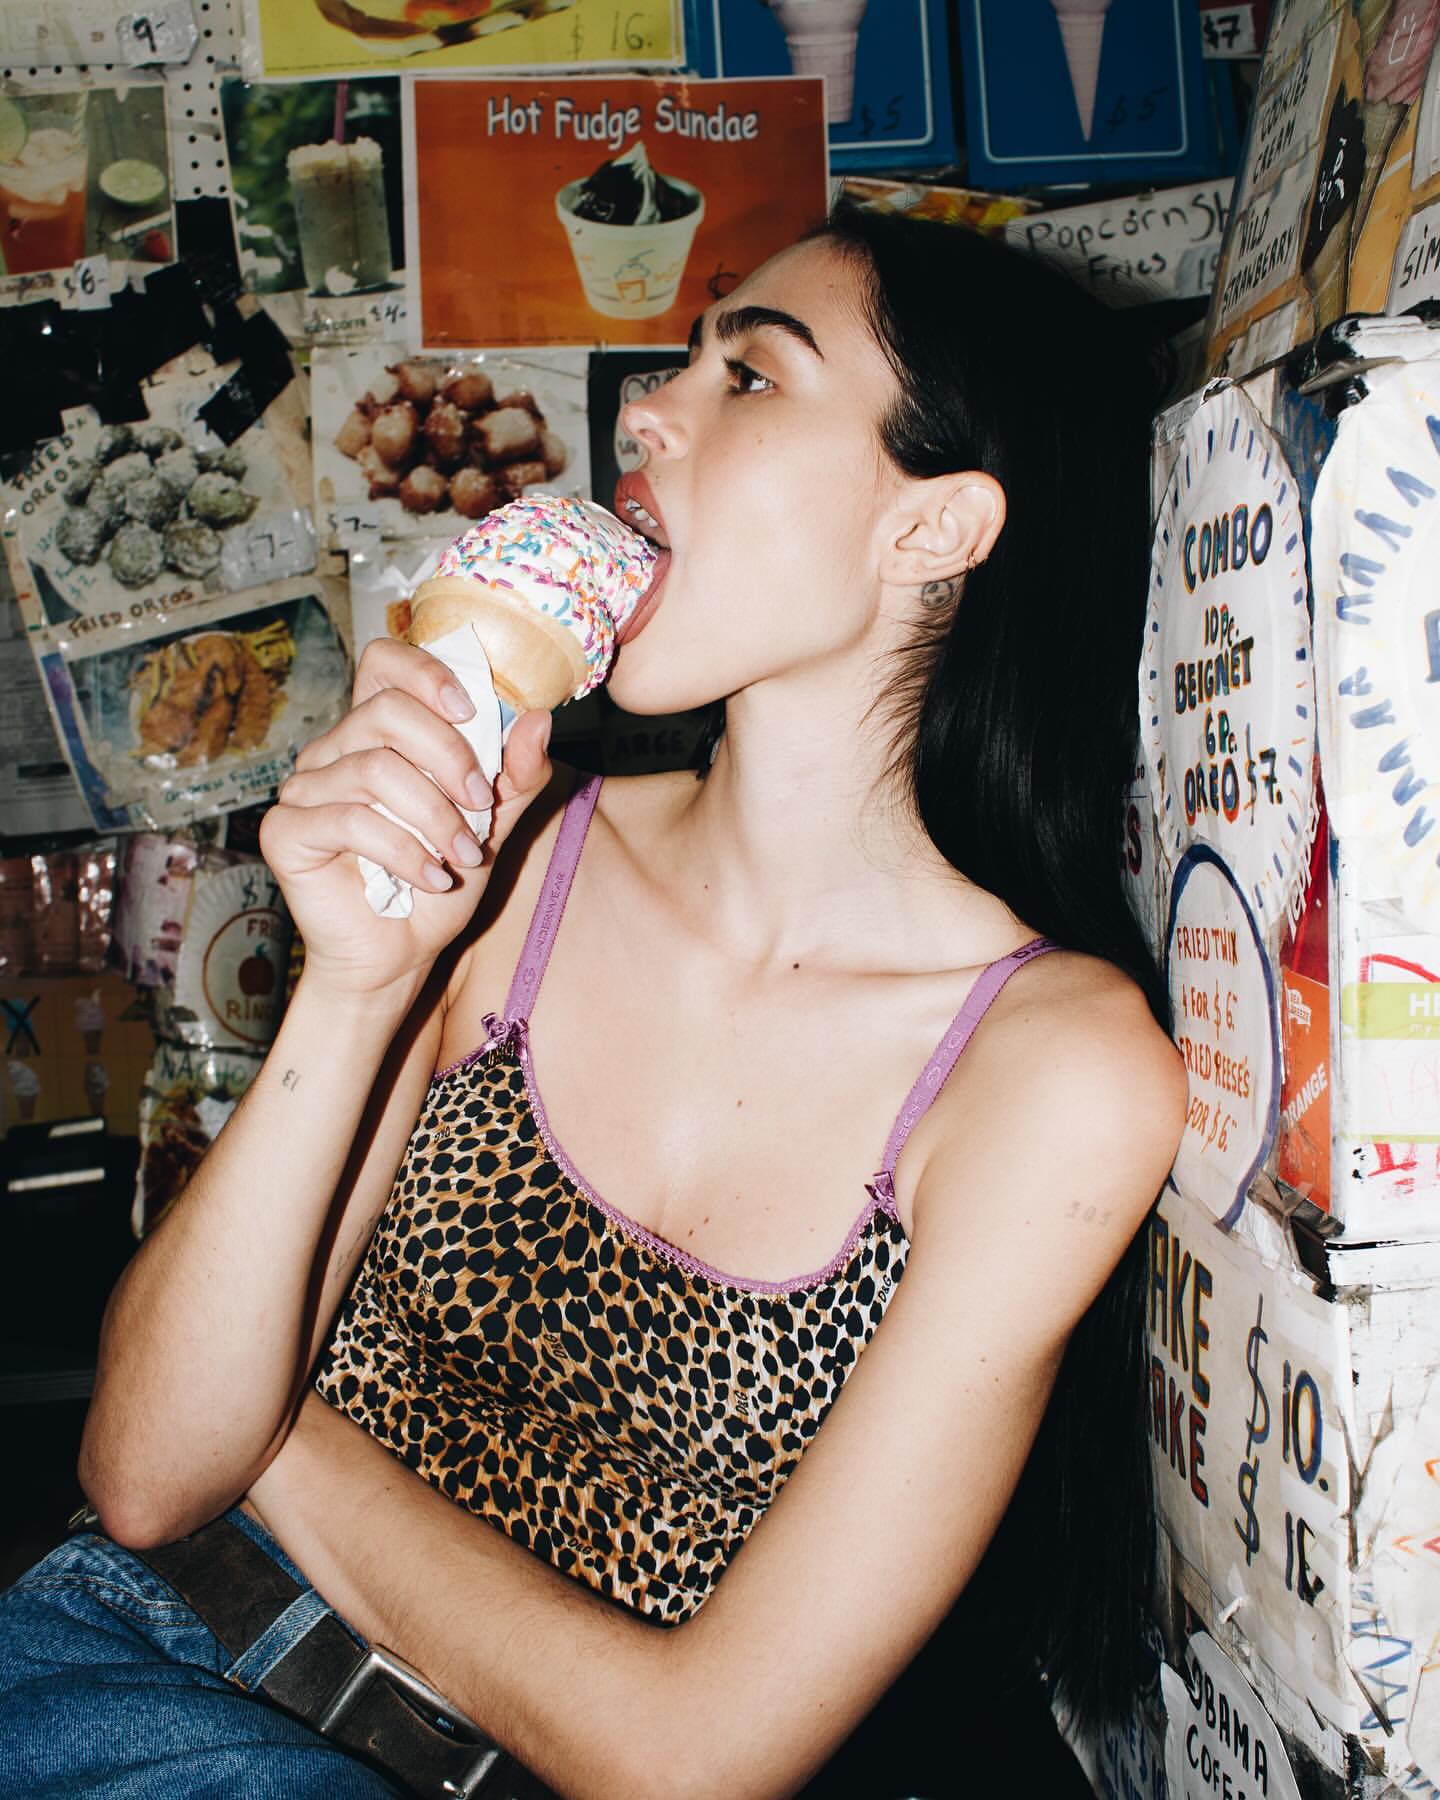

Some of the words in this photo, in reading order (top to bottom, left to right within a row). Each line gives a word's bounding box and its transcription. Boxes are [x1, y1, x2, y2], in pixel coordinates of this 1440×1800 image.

[1203, 14, 1241, 48] $7
[487, 95, 542, 136] Hot
[555, 98, 641, 150] Fudge
[655, 96, 759, 142] Sundae
[1253, 112, 1297, 184] CREAM
[1222, 224, 1295, 314] STRAWBERRY
[22, 456, 80, 515] OREOS
[1180, 502, 1273, 594] COMBO
[68, 610, 122, 638] FRIED
[1174, 634, 1255, 716] BEIGNET
[1184, 757, 1241, 827] OREO
[534, 870, 566, 956] UNDERWEAR
[1176, 925, 1210, 962] FRIED
[1190, 985, 1210, 1021] FOR
[1179, 1036, 1212, 1081] FRIED
[877, 1273, 893, 1304] D&G
[1149, 1213, 1213, 1410] AKE
[734, 1389, 750, 1417] D&G
[1149, 1354, 1209, 1510] AKE
[1189, 1655, 1268, 1799] OBAMA
